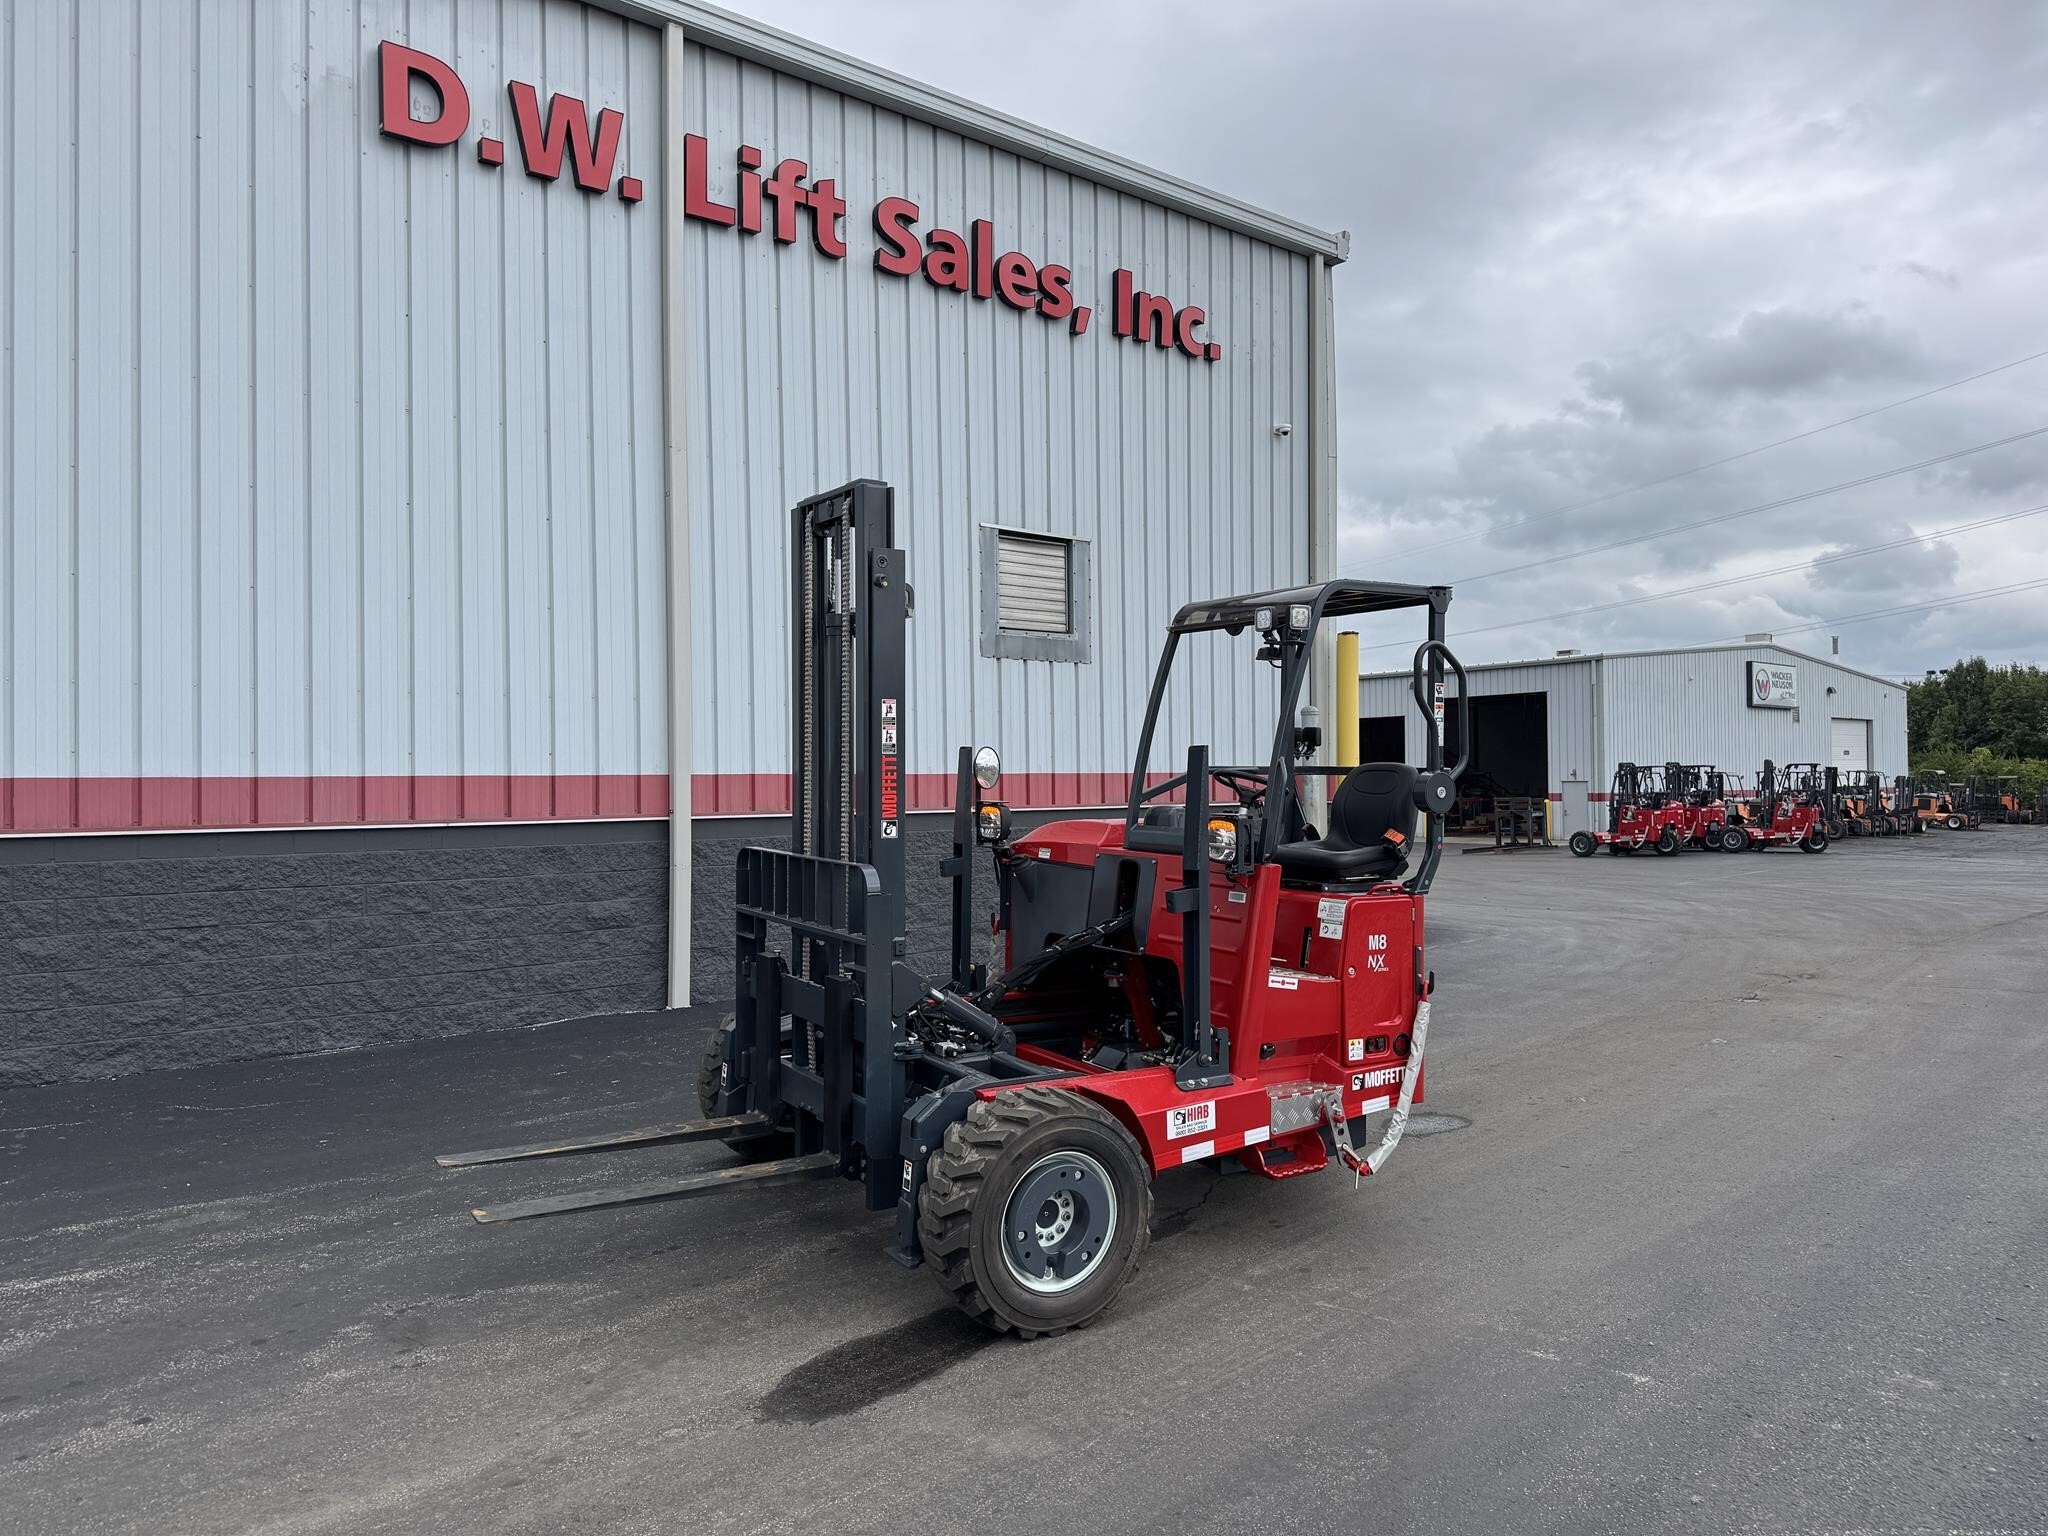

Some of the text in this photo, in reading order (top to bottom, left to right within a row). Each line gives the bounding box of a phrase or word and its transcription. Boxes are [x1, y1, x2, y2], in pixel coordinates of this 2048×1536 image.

[377, 39, 1222, 363] D.W. Lift Sales, Inc.
[1770, 671, 1792, 681] WACKER
[1771, 680, 1793, 689] NEUSON
[881, 755, 897, 819] MOFFETT
[1368, 934, 1387, 950] M8
[1367, 953, 1385, 972] NX
[1365, 1065, 1406, 1088] MOFFETT
[1187, 1104, 1209, 1122] HIAB
